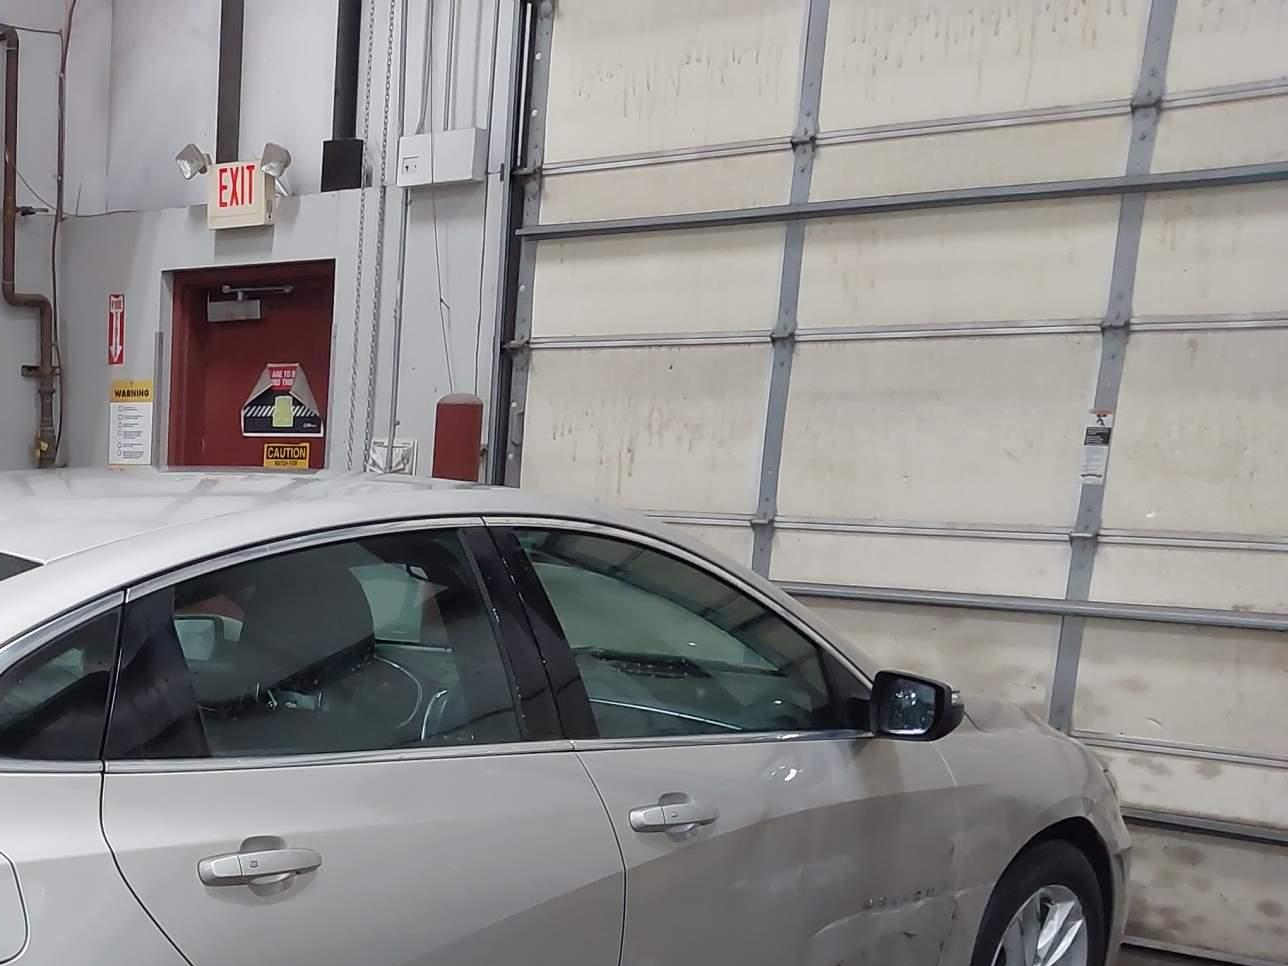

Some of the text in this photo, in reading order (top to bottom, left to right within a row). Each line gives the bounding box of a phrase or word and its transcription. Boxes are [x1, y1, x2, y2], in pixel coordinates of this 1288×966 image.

[219, 165, 255, 207] EXIT
[114, 389, 149, 398] WARNING
[267, 447, 306, 458] CAUTION
